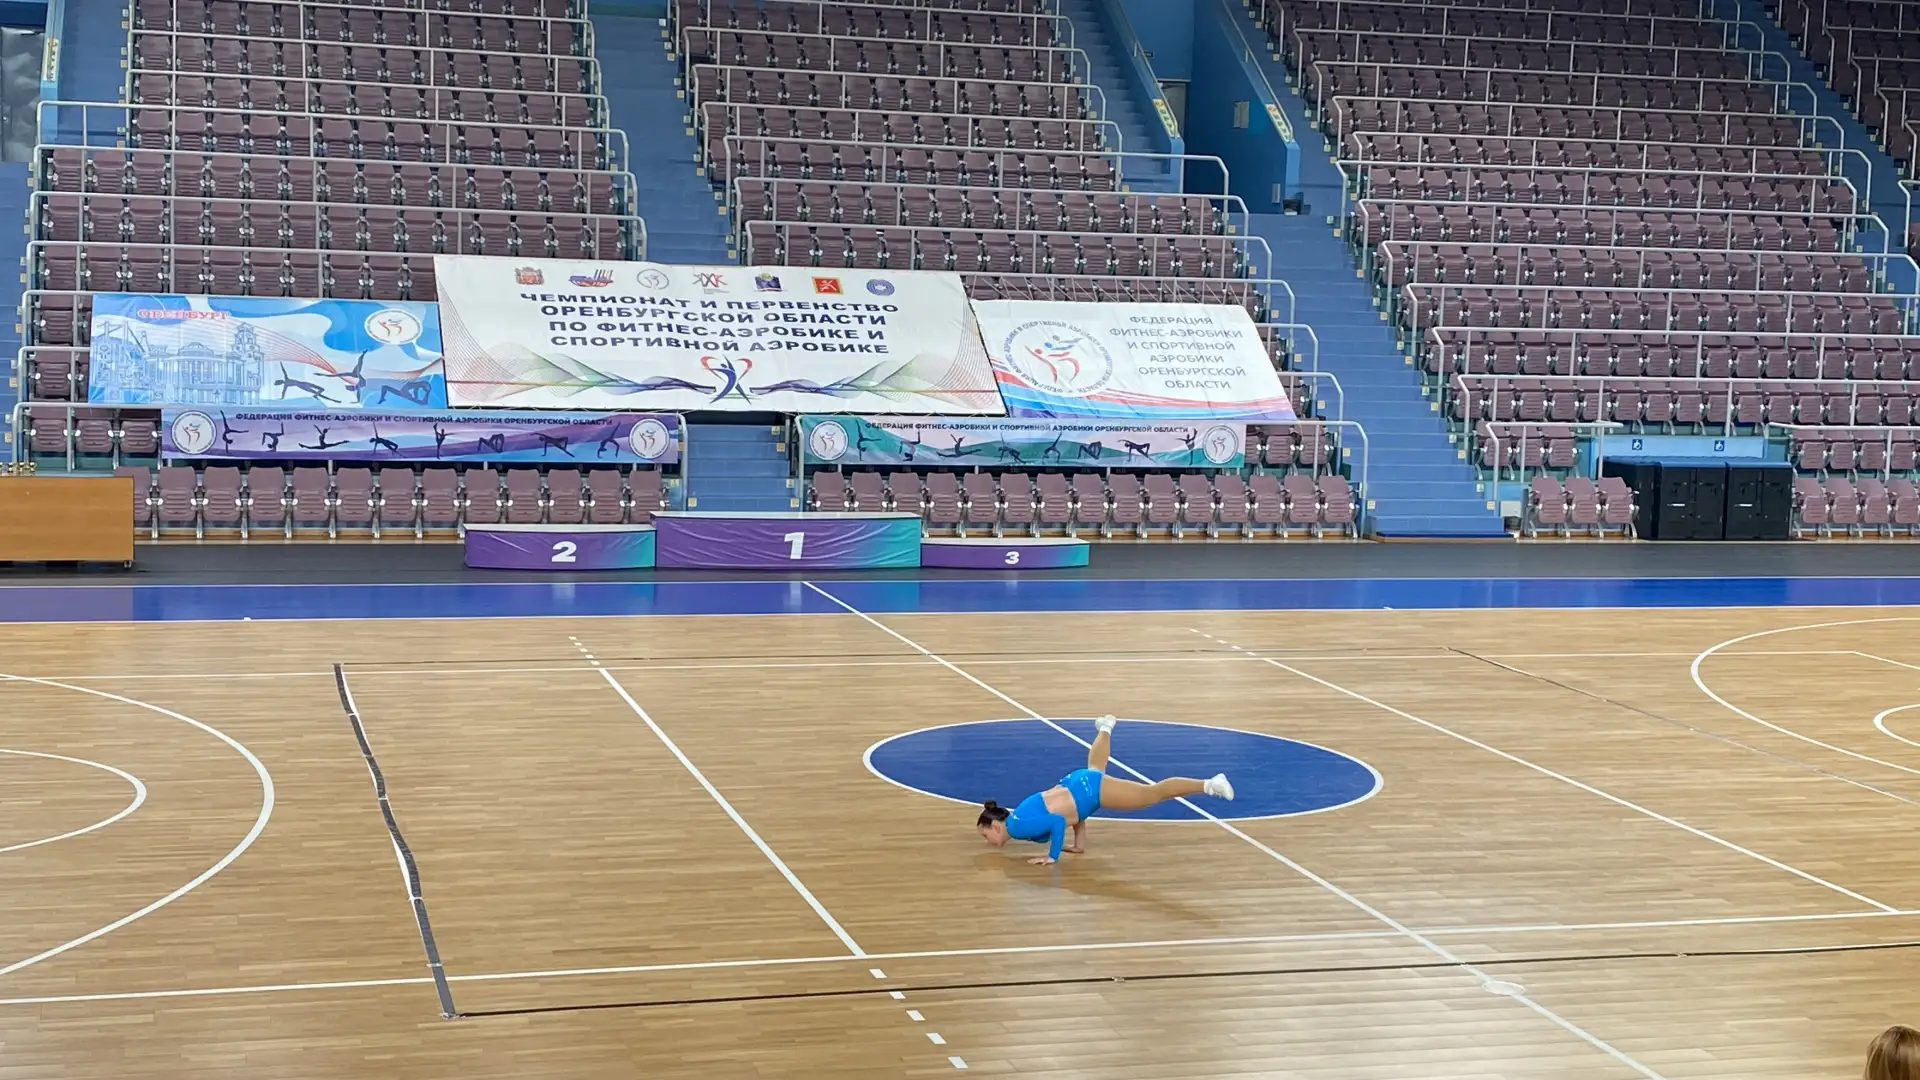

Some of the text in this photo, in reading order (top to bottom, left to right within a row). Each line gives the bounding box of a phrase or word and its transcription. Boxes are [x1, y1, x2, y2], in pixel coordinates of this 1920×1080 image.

[520, 293, 899, 313] ЧЕМПИОНАТ И ПЕРВЕНСТВО
[138, 309, 231, 321] ОРЕНБУРГ
[541, 305, 887, 326] ОРЕНБУРГСКОЙ ОБЛАСТИ
[1129, 316, 1214, 326] ФЕДЕРАЦИЯ
[549, 321, 885, 340] ПО ФИТНЕС-АЭРОБИКЕ И
[1109, 328, 1243, 338] ФИТНЕС-АЭРОБИКИ
[551, 336, 889, 354] СПОРТИВНОЙ АЭРОБИКЕ
[1127, 341, 1236, 351] И СПОРТИВНОЙ
[1150, 354, 1225, 363] АЭРОБИКИ
[1138, 366, 1247, 377] ОРЕНБУРГСКОЙ
[1164, 380, 1232, 389] ОБЛАСТИ
[235, 413, 293, 421] ФЕДЕРАЦИЯ
[393, 414, 454, 423] СПОРТИВНОЙ
[504, 416, 571, 425] ОРЕНБУРГСКОЙ
[572, 418, 613, 426] ОБЛАСТИ
[865, 422, 914, 430] ФЕДЕРАЦИЯ
[914, 423, 991, 431] ФИТНЕС-АЭРОБИКИ
[1052, 424, 1093, 432] АЭРОБИКИ
[1094, 424, 1152, 432] ОРЕНБУРГСКОЙ
[551, 541, 577, 563] 2
[783, 532, 805, 560] 1
[1004, 551, 1021, 565] 3
